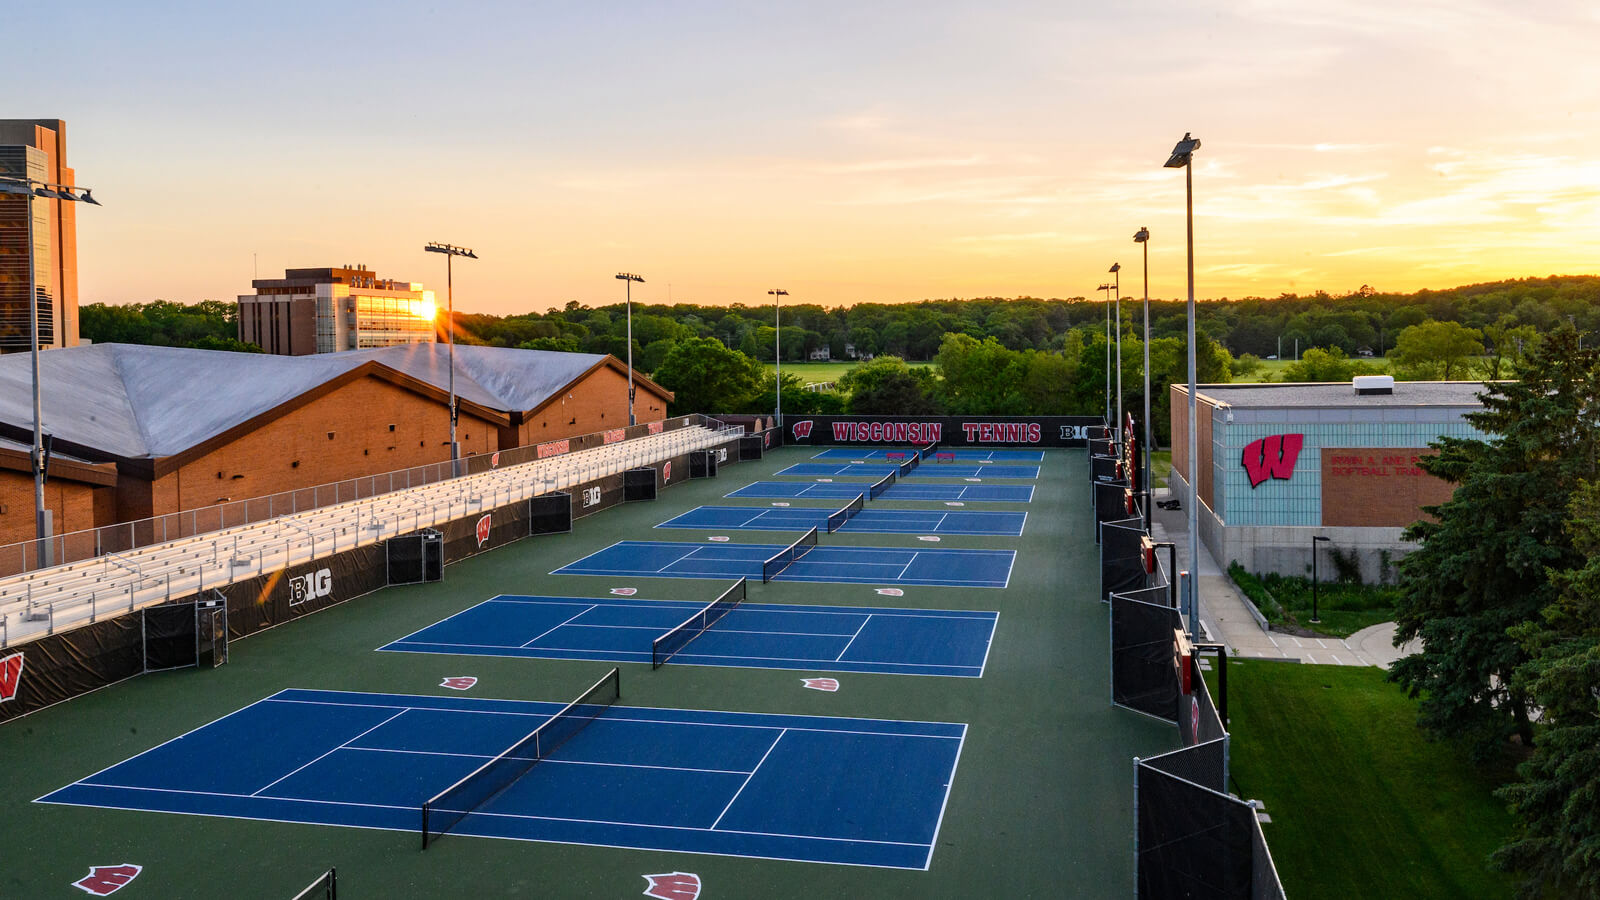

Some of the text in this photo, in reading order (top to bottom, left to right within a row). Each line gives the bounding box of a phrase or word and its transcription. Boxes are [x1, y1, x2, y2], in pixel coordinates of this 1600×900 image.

[792, 420, 814, 441] W
[831, 421, 1041, 443] WISCONSIN TENNIS
[1241, 433, 1304, 489] W
[1382, 455, 1405, 465] AND
[1331, 466, 1392, 477] SOFTBALL
